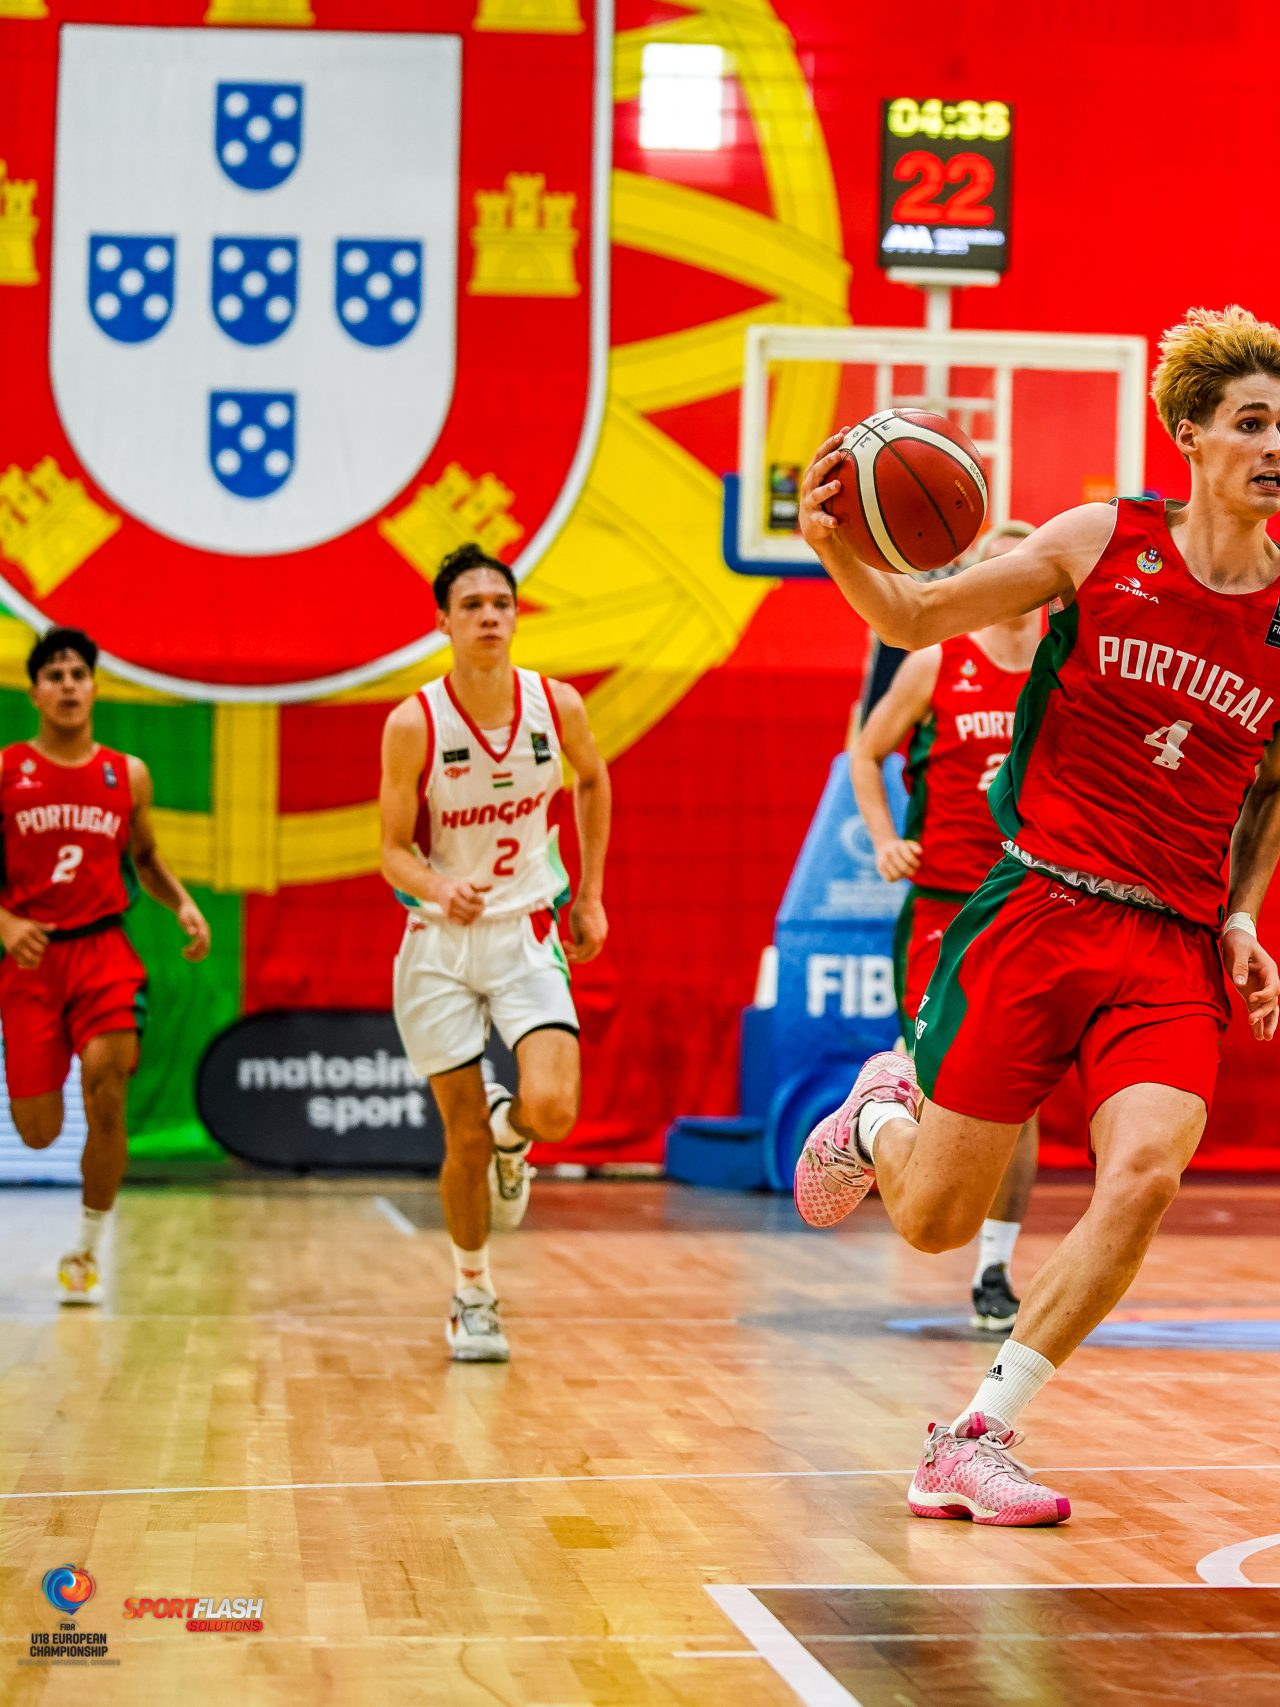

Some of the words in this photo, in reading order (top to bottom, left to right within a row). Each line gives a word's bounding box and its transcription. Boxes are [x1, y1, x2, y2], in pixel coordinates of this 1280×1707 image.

[888, 97, 1011, 141] 04:38
[891, 150, 996, 226] 22
[1114, 582, 1160, 604] DHIKA
[1098, 635, 1275, 734] PORTUGAL
[956, 710, 1016, 742] PORT
[1143, 719, 1194, 771] 4
[16, 803, 122, 840] PORTUGAL
[441, 791, 546, 829] HUNGA
[51, 844, 84, 884] 2
[492, 837, 520, 877] 2
[806, 954, 897, 1020] FIB
[237, 1050, 430, 1091] matosin
[306, 1090, 426, 1136] sport
